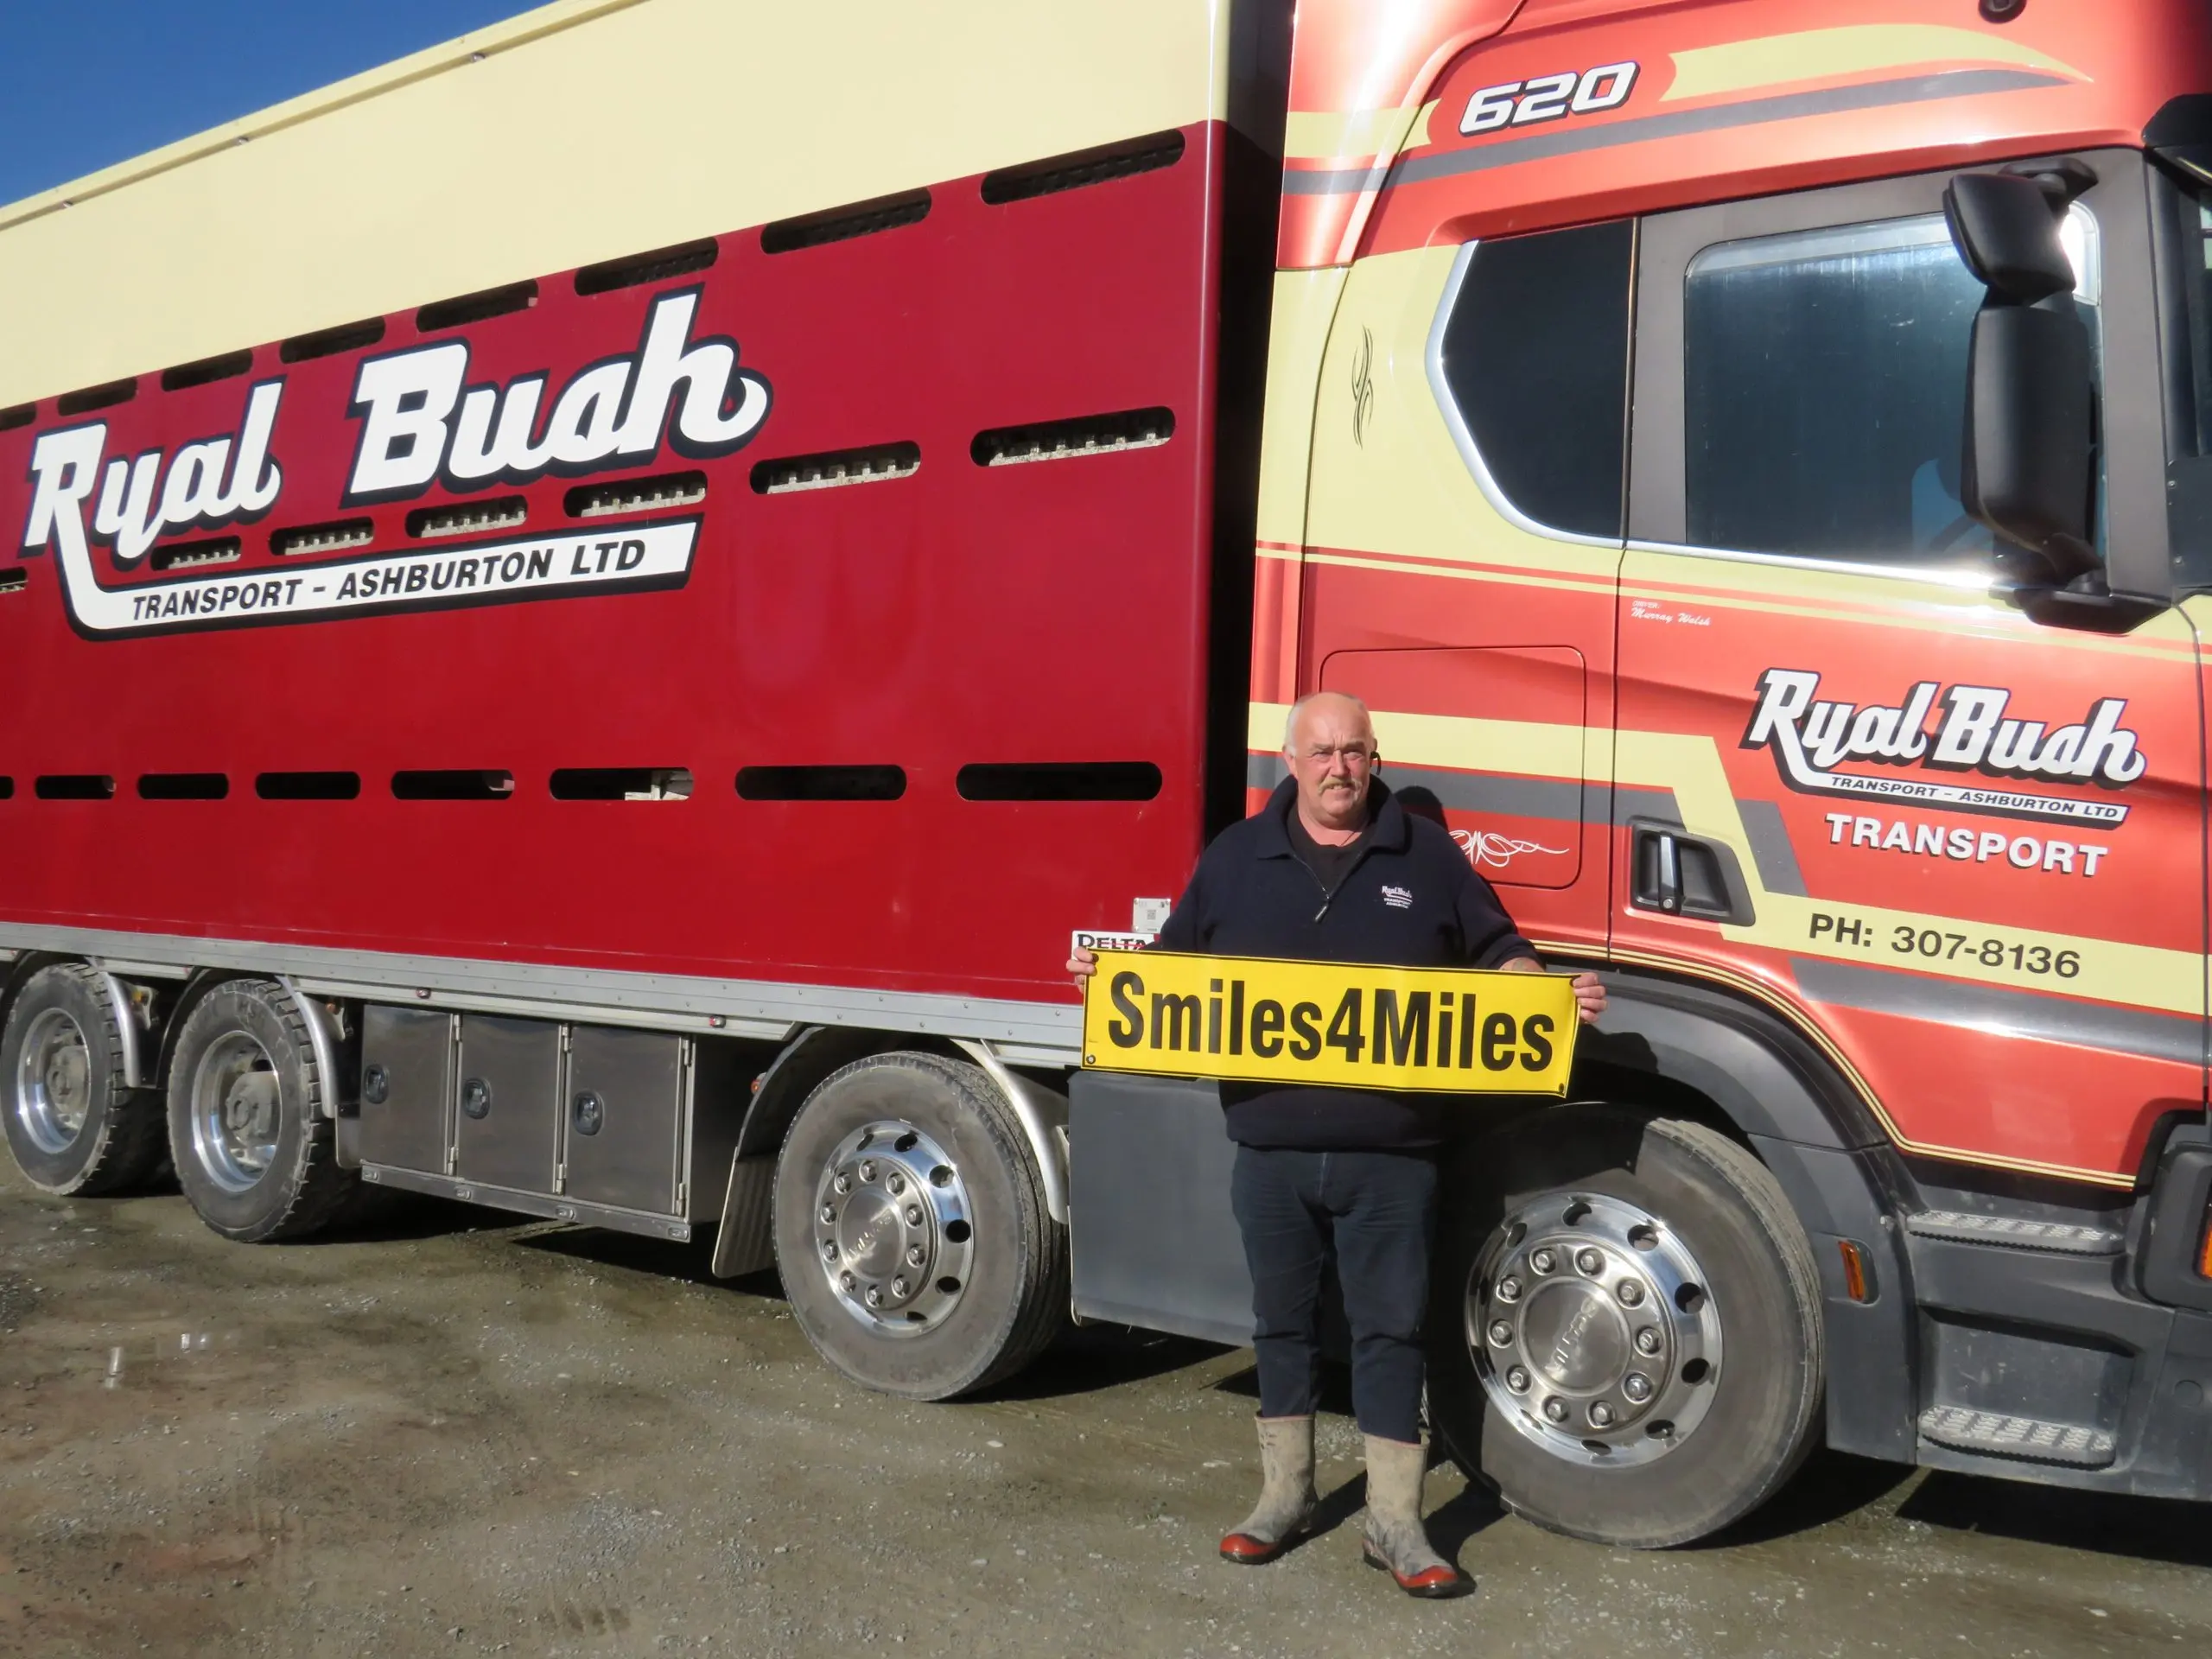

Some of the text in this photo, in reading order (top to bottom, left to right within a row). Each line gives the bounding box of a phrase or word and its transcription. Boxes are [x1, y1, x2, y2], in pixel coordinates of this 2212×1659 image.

[1459, 60, 1641, 137] 620
[22, 380, 284, 563] Ryal
[133, 578, 303, 620] TRANSPORT
[336, 548, 555, 601] ASHBURTON
[569, 538, 646, 576] LTD
[1630, 607, 1674, 624] Murray
[1745, 668, 1929, 769] Ryal
[1831, 775, 1939, 798] TRANSPORT
[1958, 789, 2075, 814] ASHBURTON
[2083, 804, 2119, 818] LTD
[1825, 812, 2109, 878] TRANSPORT
[1077, 933, 1147, 951] DELTA
[1808, 912, 2082, 979] PH: 307-8136
[1107, 969, 1555, 1072] Smiles4Miles
